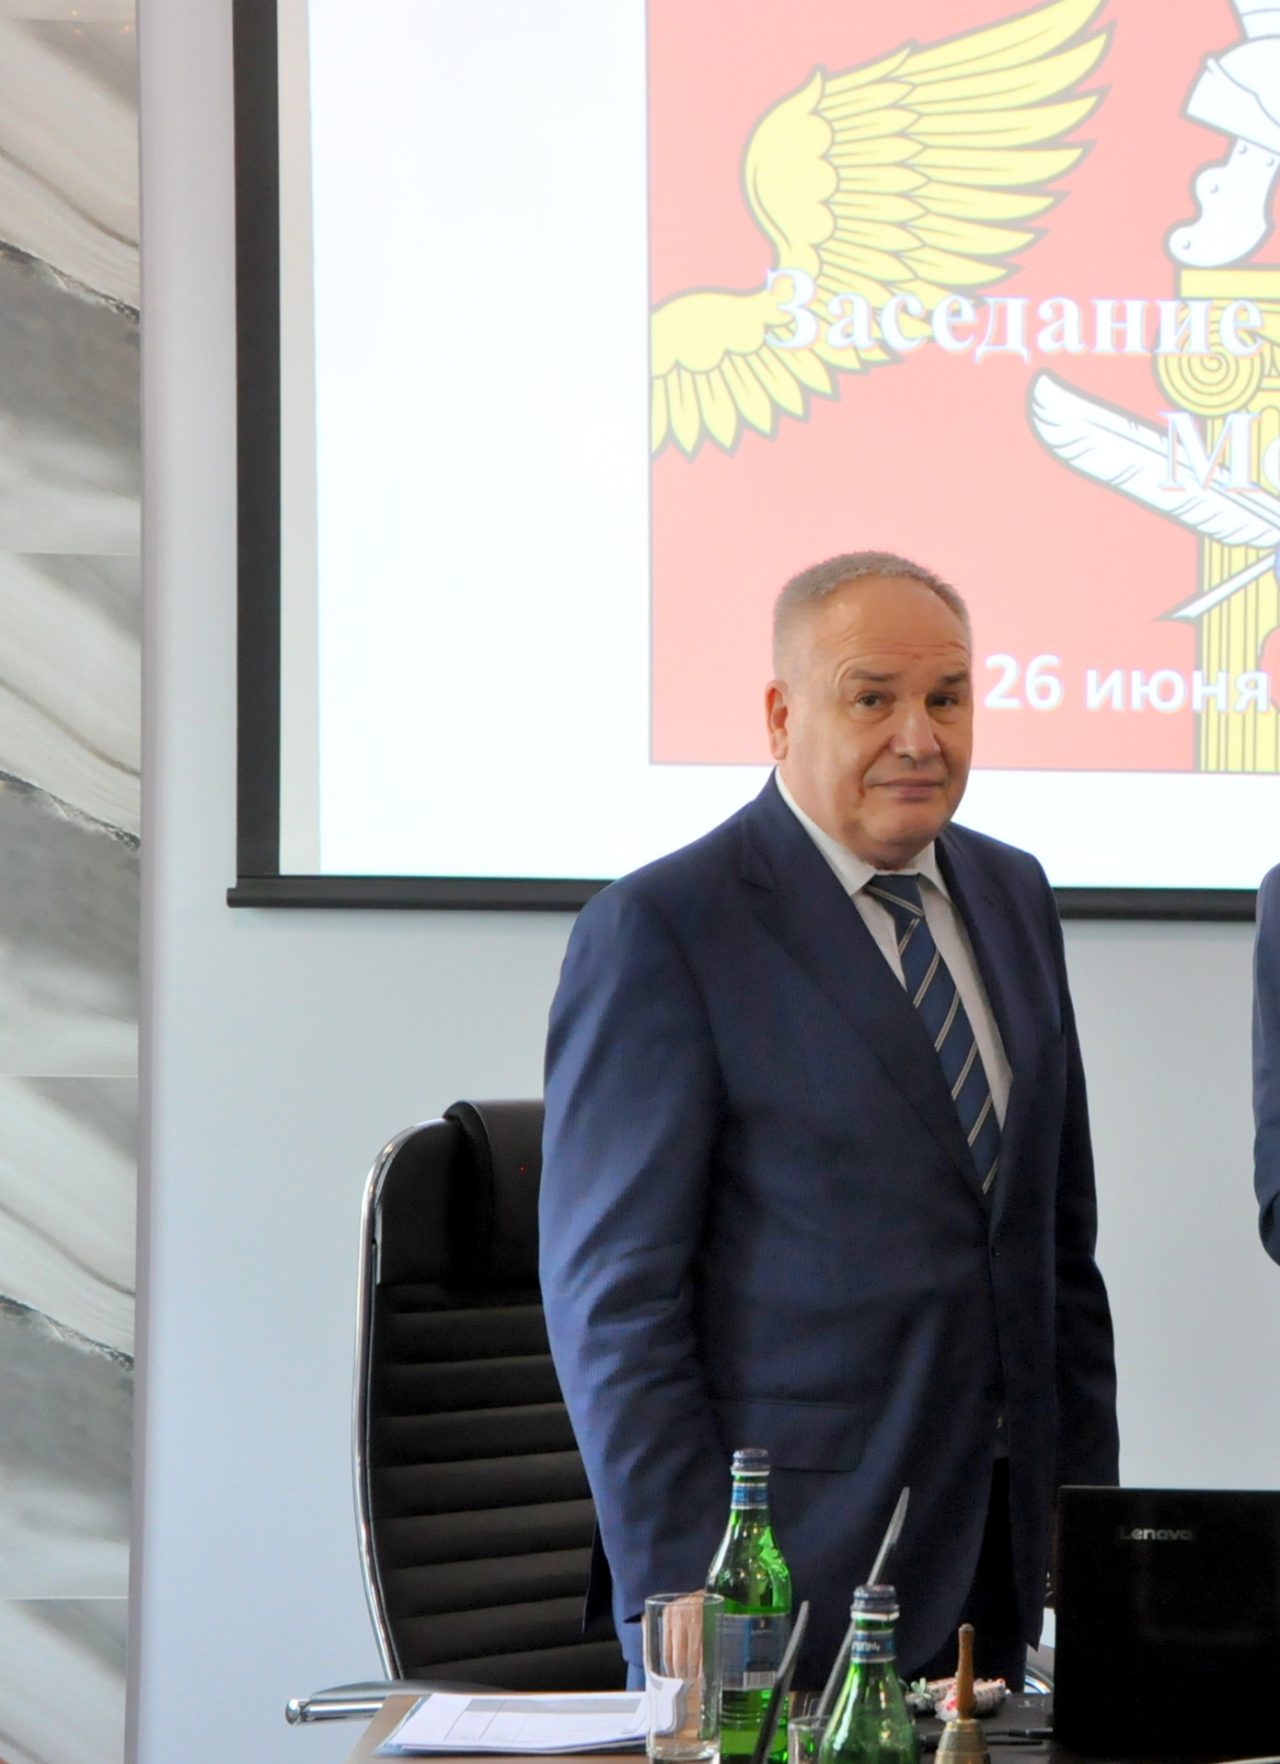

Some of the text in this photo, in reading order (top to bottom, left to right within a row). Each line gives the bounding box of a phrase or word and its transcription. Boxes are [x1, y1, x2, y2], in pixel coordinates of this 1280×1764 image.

[764, 267, 1265, 365] Заседание
[984, 653, 1063, 711] 26
[1084, 667, 1271, 713] июня
[1120, 1526, 1193, 1540] Lenovo
